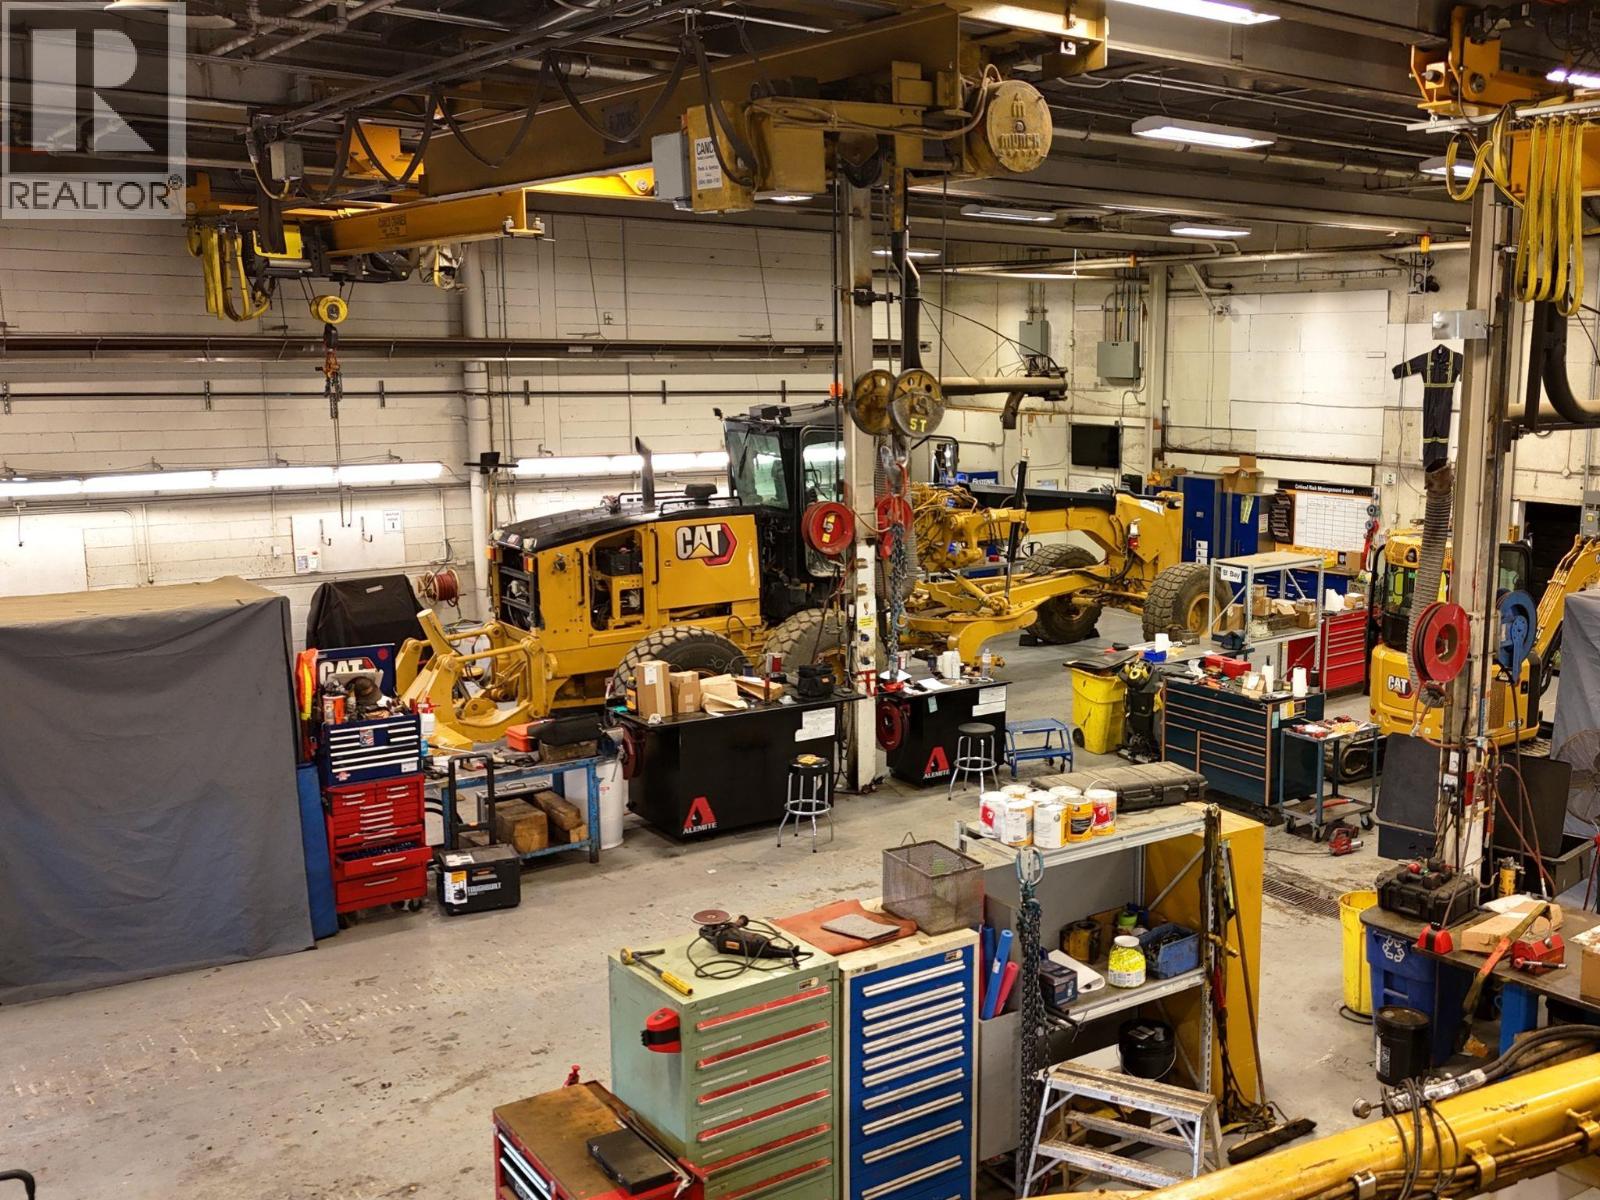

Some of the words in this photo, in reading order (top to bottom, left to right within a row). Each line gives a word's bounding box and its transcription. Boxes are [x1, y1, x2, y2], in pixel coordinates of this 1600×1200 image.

[1317, 485, 1341, 493] Management
[676, 524, 722, 560] CAT
[1229, 570, 1240, 580] Bay
[319, 659, 363, 687] CAT
[1388, 675, 1408, 695] CAT
[922, 769, 950, 780] ALEMITE
[682, 821, 718, 835] ALEMITE
